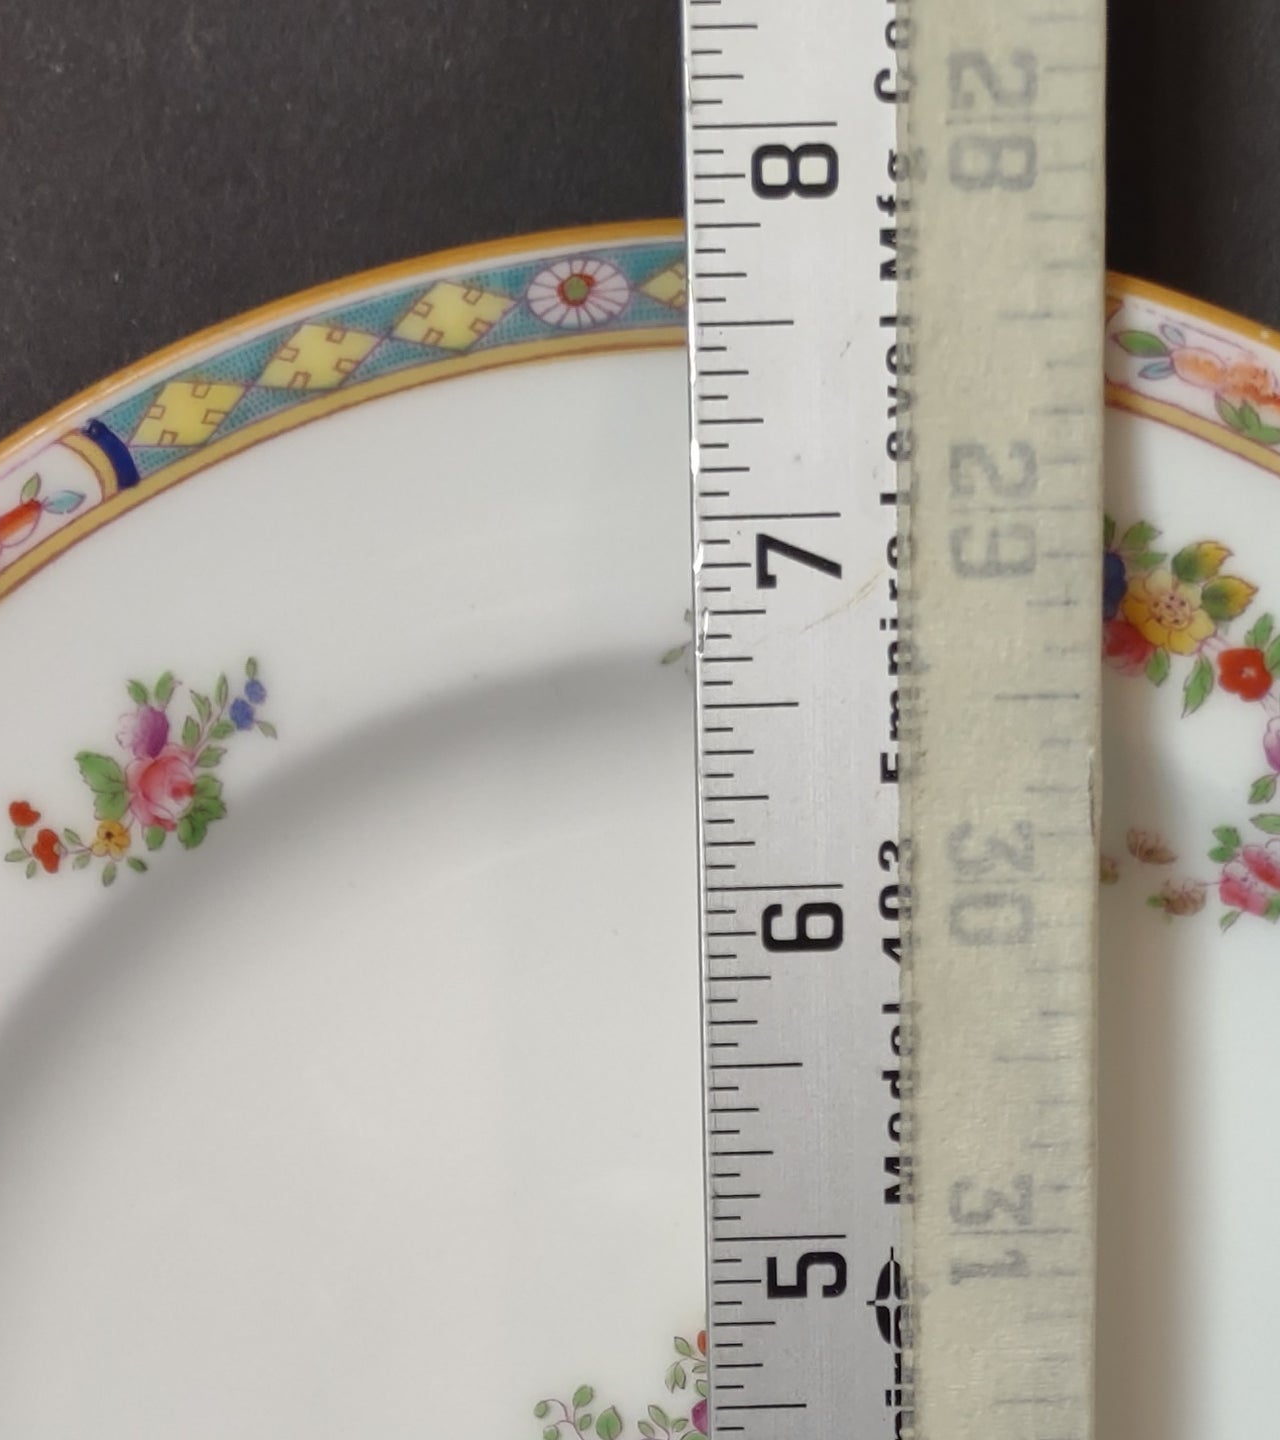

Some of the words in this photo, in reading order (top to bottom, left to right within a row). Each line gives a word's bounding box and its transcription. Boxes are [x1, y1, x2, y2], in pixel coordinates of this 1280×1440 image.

[947, 49, 1038, 192] 28
[751, 143, 839, 199] 8
[948, 440, 1038, 578] 29
[756, 533, 842, 589] 7
[948, 820, 1034, 946] 30
[761, 902, 844, 953] 6
[948, 1174, 1033, 1285] 31
[766, 1251, 847, 1298] 5
